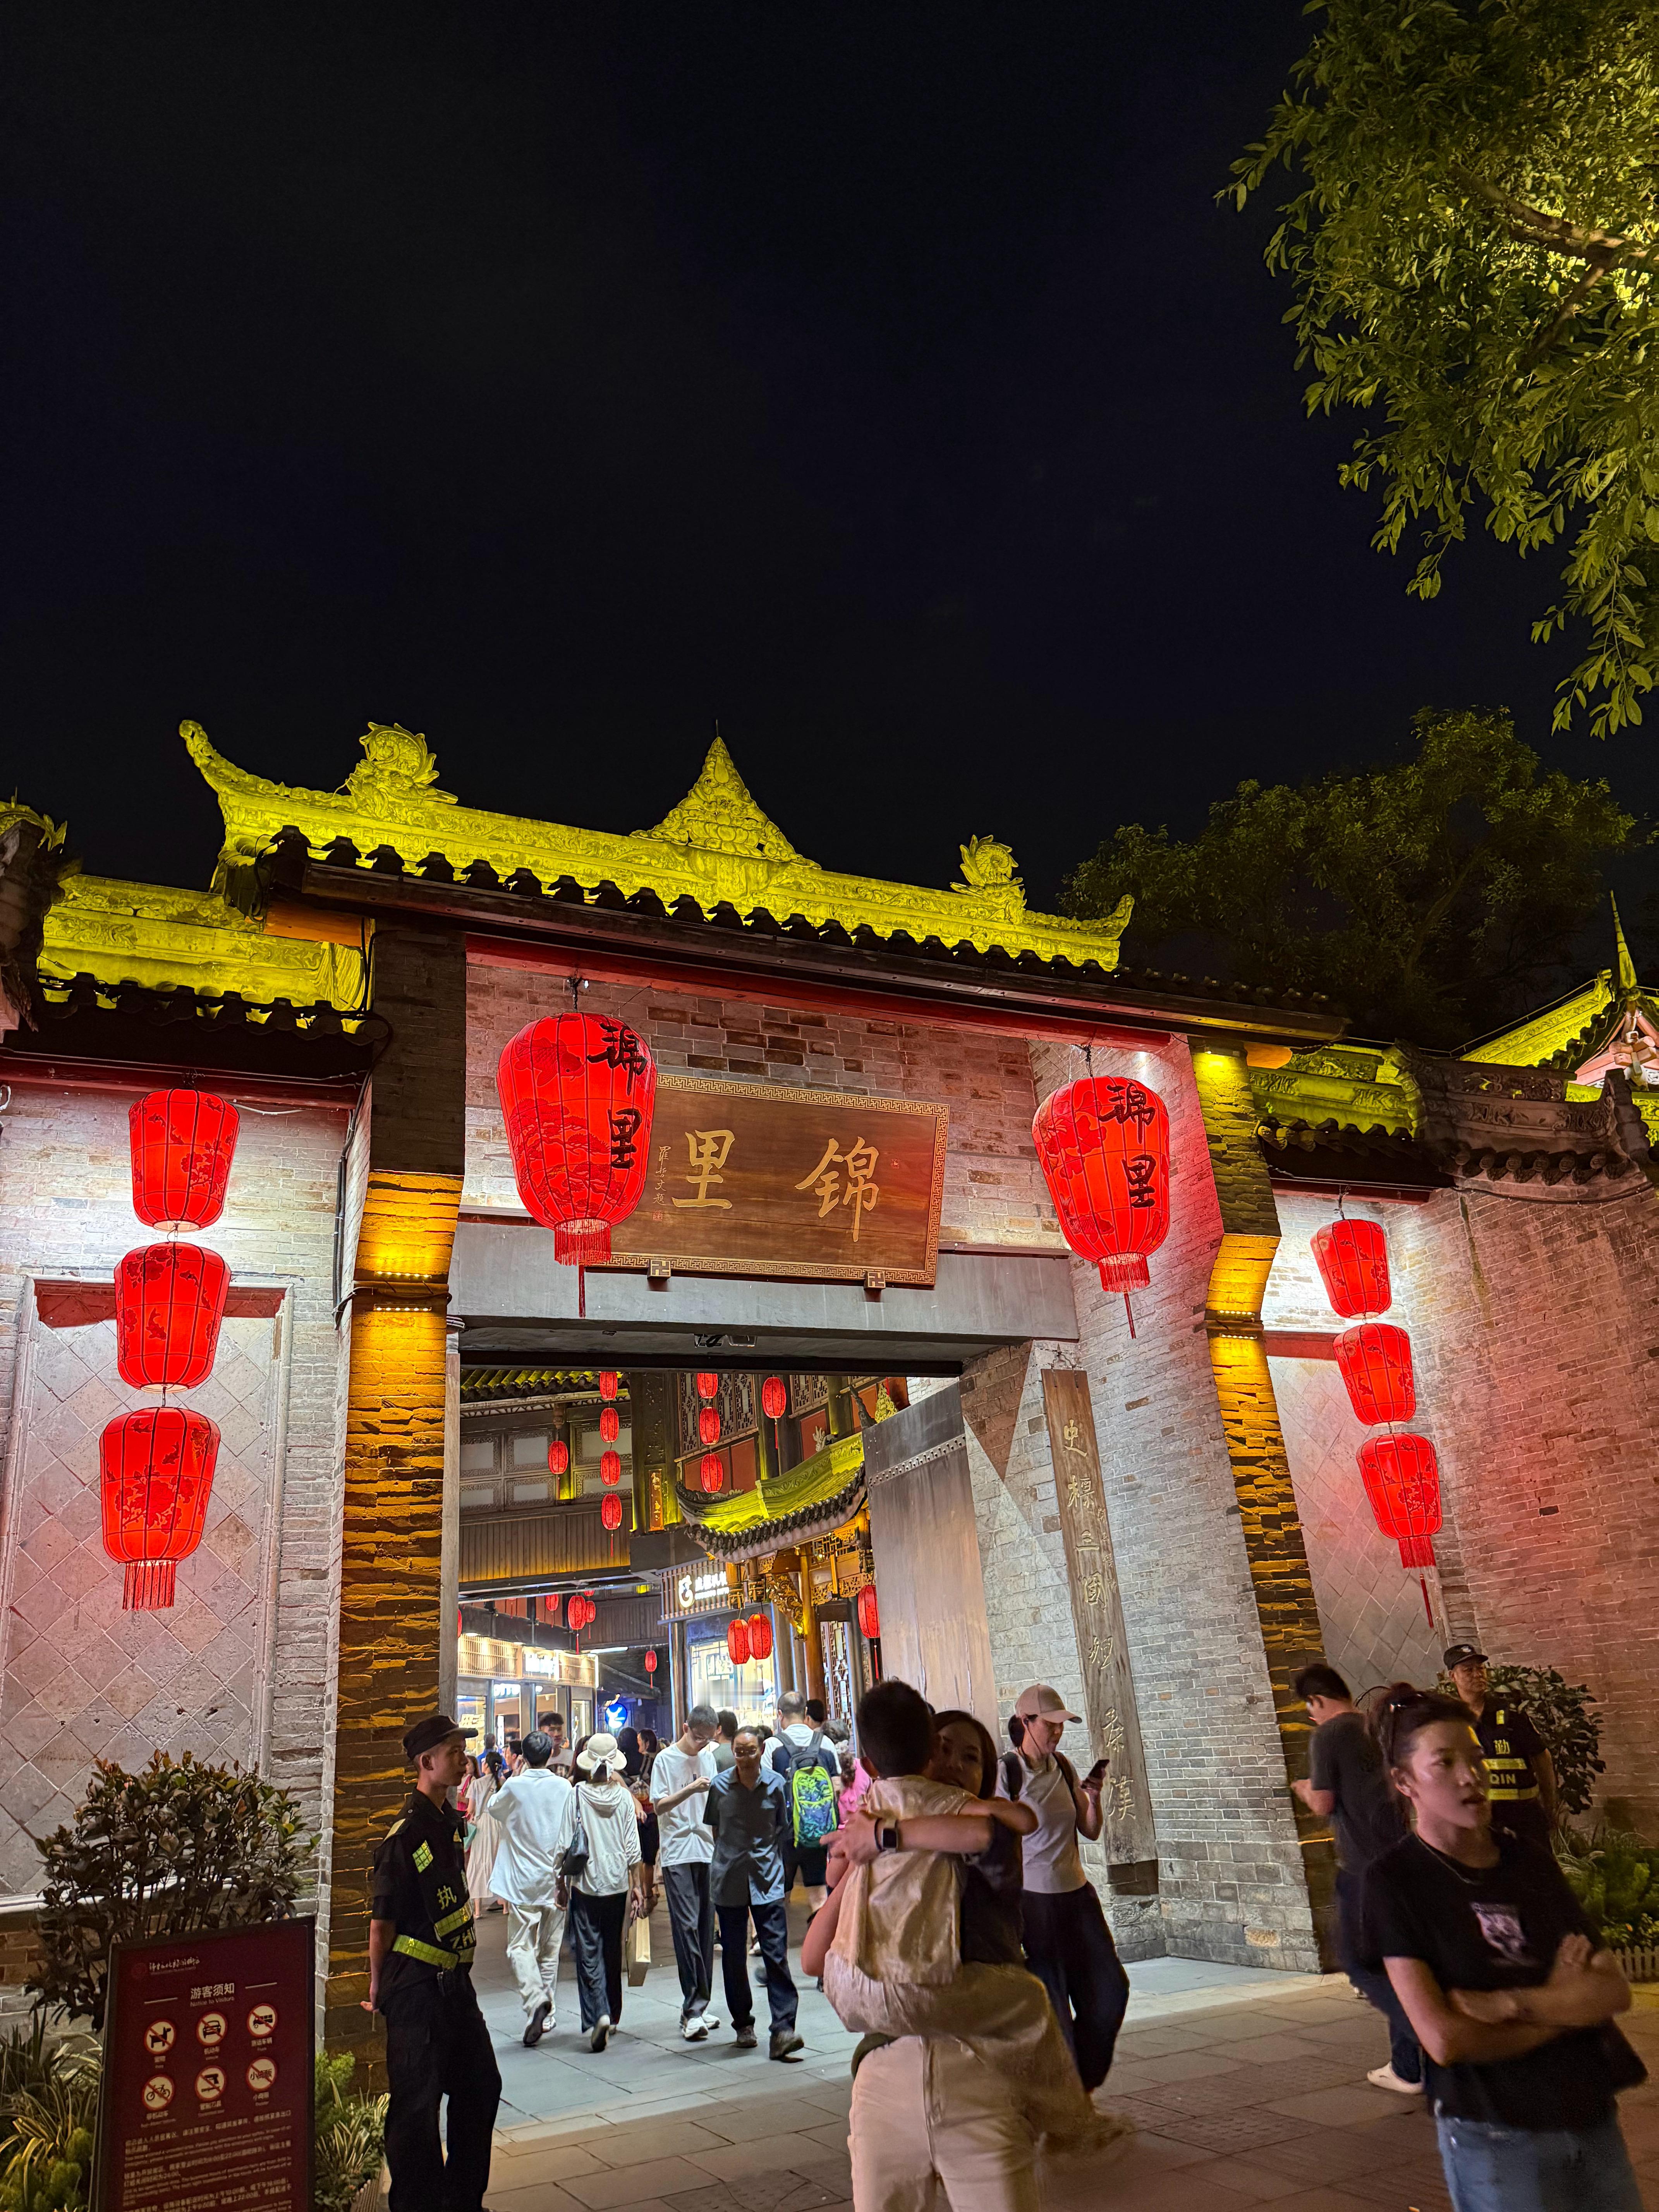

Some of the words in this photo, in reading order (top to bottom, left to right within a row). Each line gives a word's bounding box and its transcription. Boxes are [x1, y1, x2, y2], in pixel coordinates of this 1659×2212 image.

[587, 1022, 648, 1169] 锦里
[1098, 1083, 1156, 1208] 锦里
[1493, 1739, 1510, 1755] 勤
[1489, 1772, 1516, 1785] QIN
[436, 1885, 457, 1910] 执
[190, 1982, 235, 2000] 游客须知
